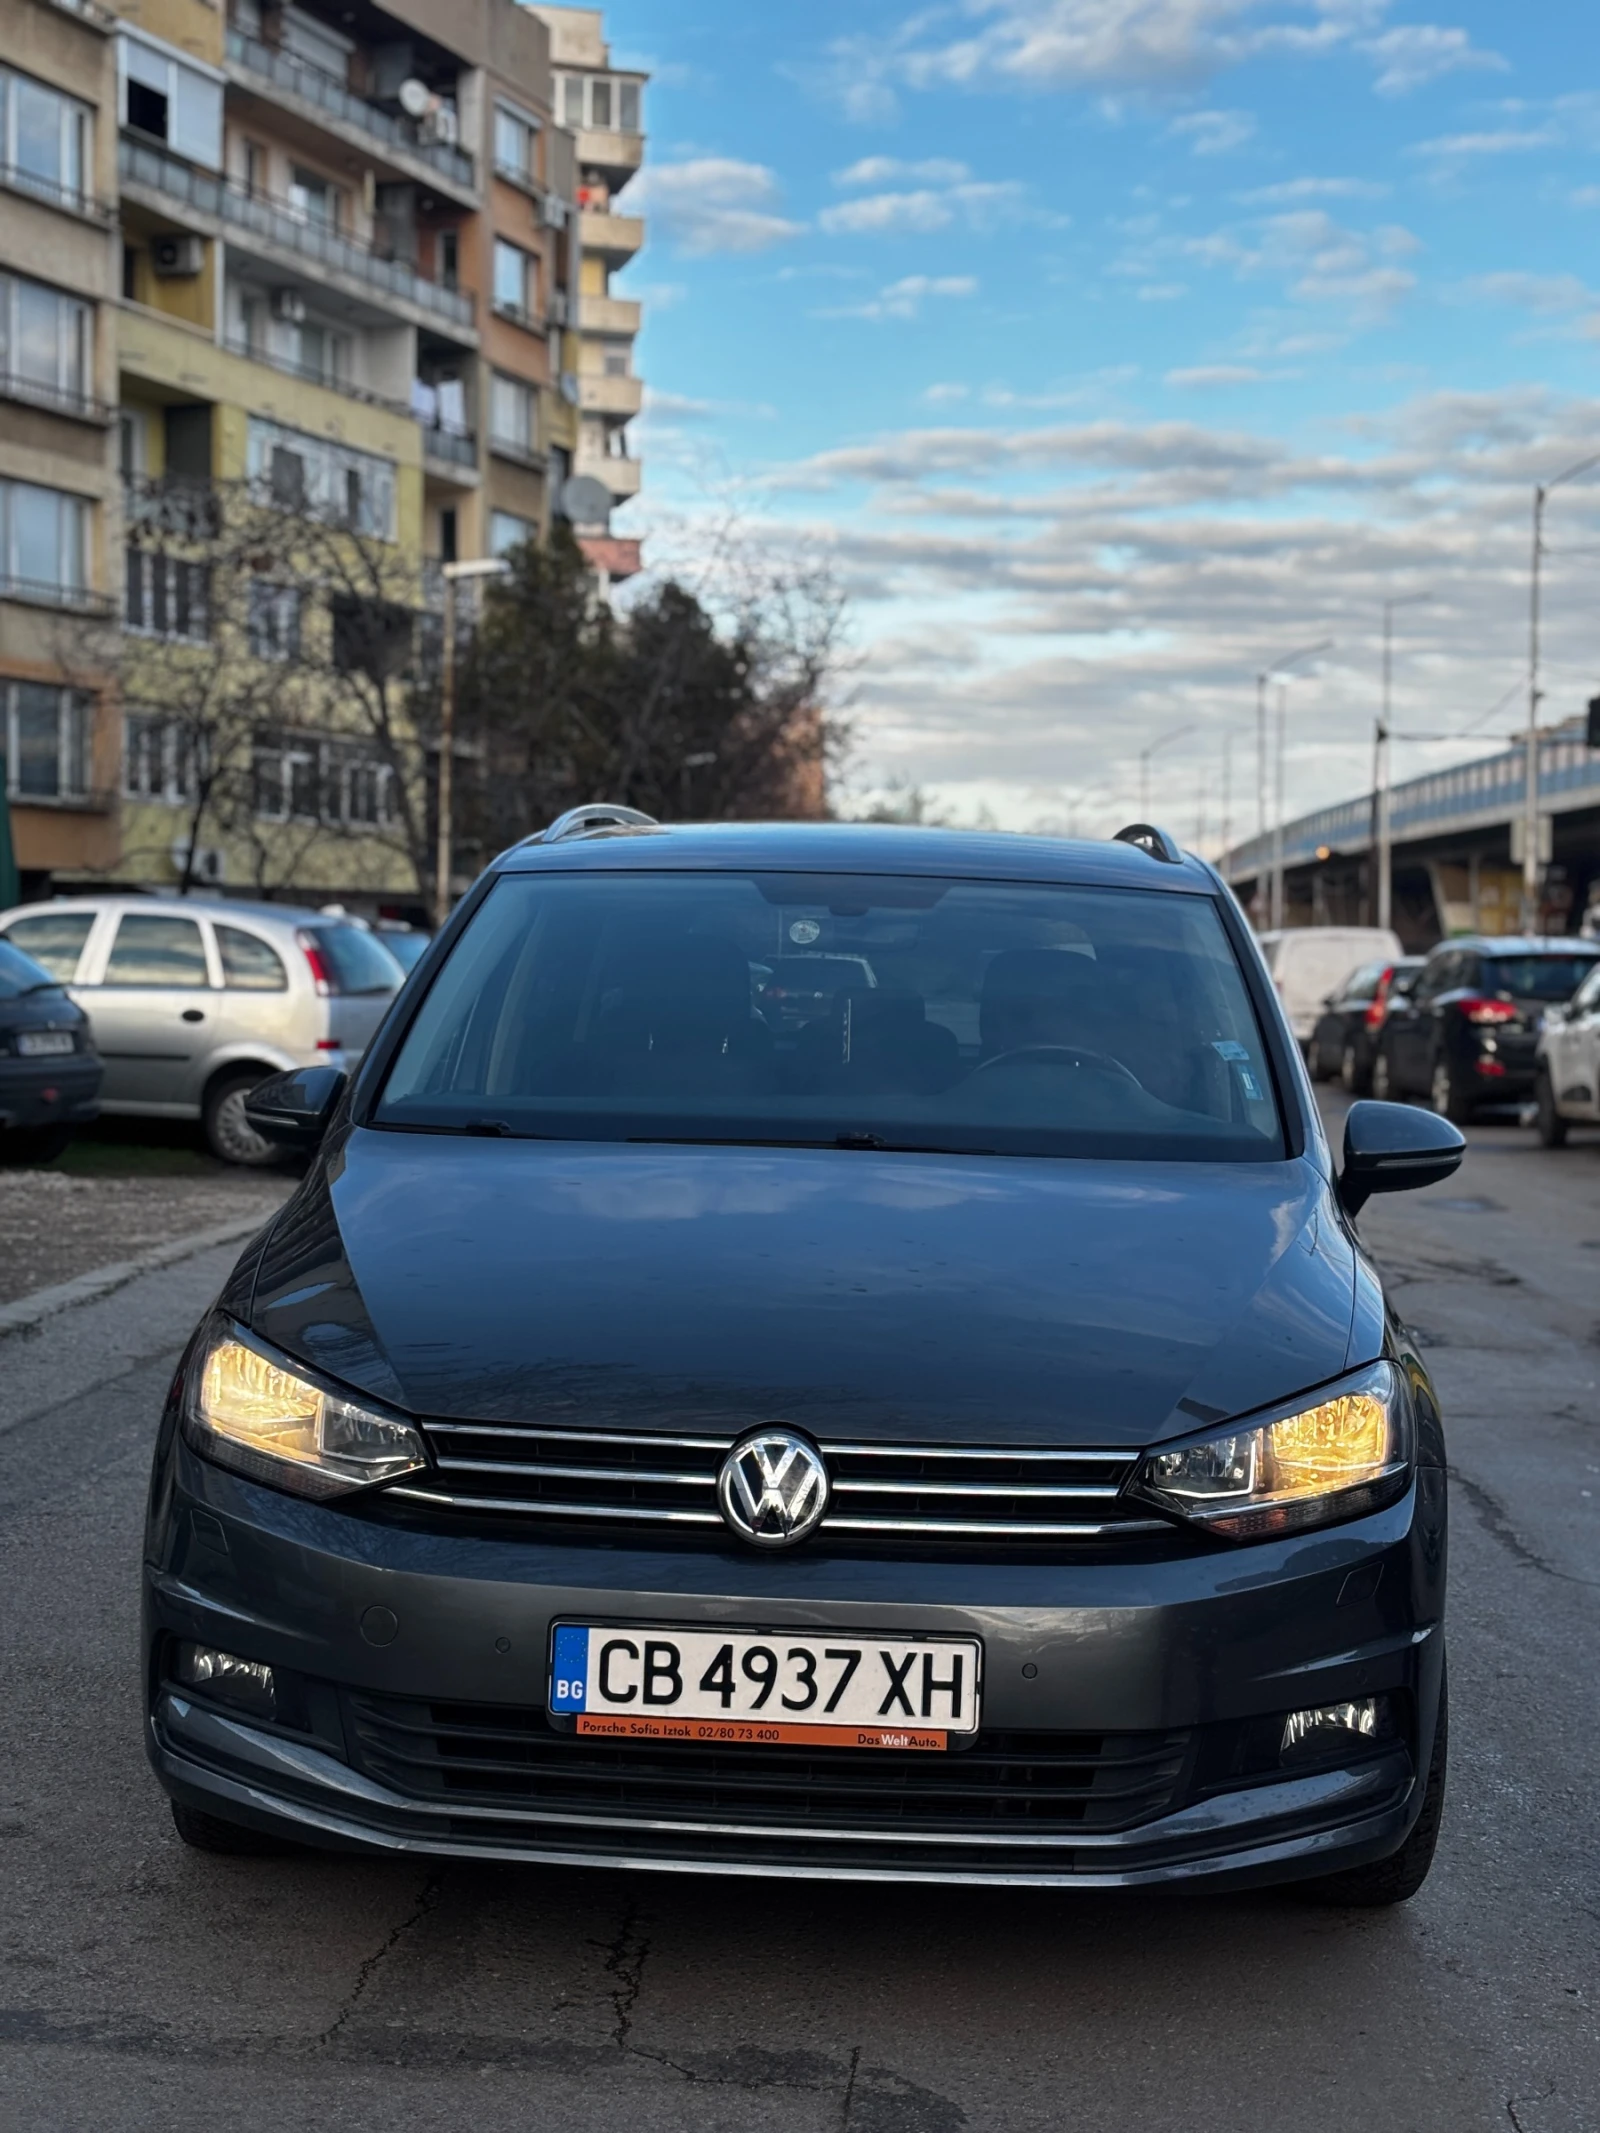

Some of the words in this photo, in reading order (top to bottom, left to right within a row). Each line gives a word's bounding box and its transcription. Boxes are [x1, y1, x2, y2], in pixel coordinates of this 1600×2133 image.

[599, 1639, 683, 1706] CB
[699, 1644, 862, 1713] 4937
[878, 1651, 963, 1719] XH
[557, 1680, 583, 1700] BG
[582, 1721, 626, 1734] Porsche
[630, 1724, 660, 1736] Sofia
[663, 1726, 691, 1737] Iztok
[698, 1726, 735, 1739] 02/80
[738, 1728, 753, 1740] 73
[757, 1729, 780, 1741] 400
